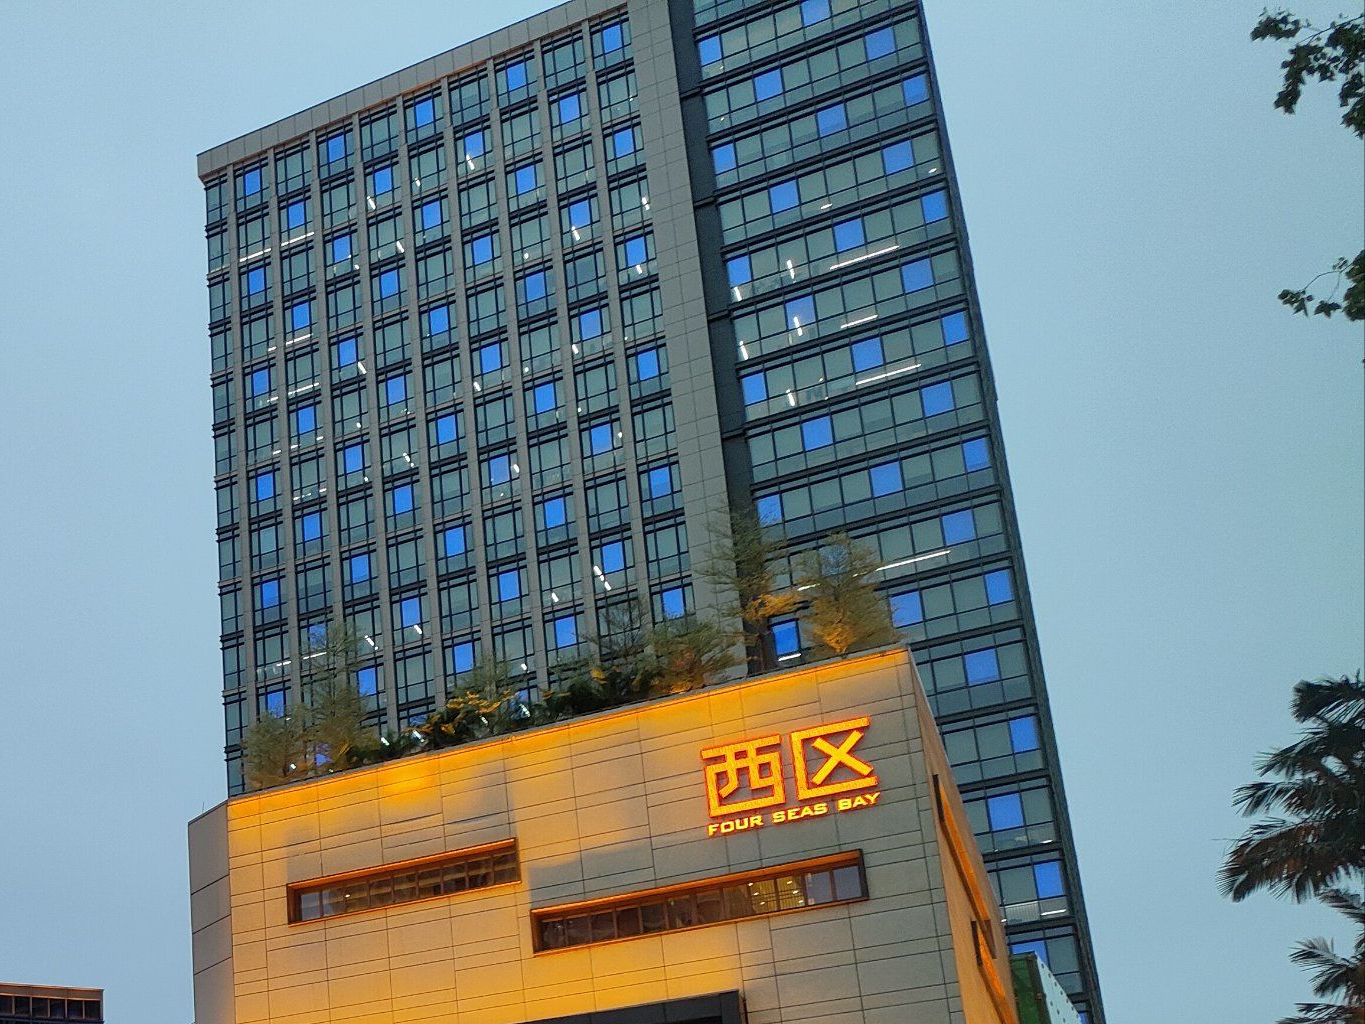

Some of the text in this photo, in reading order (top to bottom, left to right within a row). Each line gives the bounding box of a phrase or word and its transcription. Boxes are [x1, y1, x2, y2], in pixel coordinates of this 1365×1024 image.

[700, 716, 878, 818] 西区
[707, 792, 881, 837] FOUR SEAS BAY
